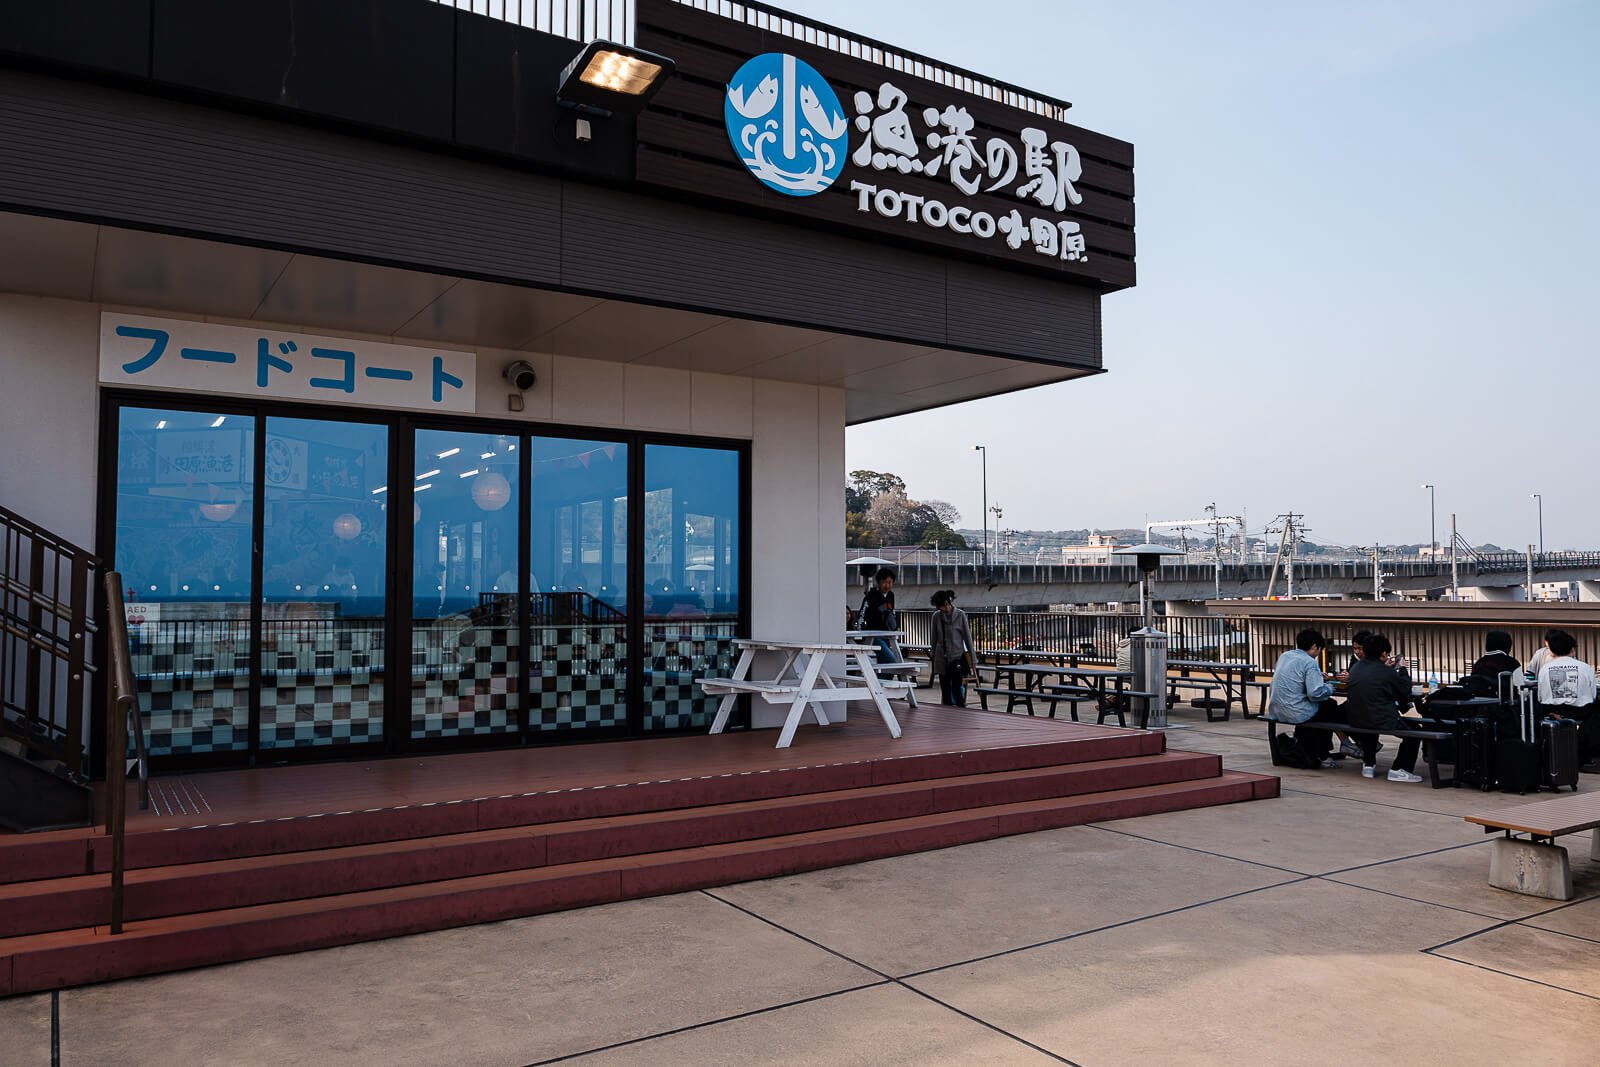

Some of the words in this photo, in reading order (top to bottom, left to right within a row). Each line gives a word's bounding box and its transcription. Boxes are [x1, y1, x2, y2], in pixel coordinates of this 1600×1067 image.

[853, 82, 1082, 212] 漁港の駅
[115, 325, 464, 402] フードコート
